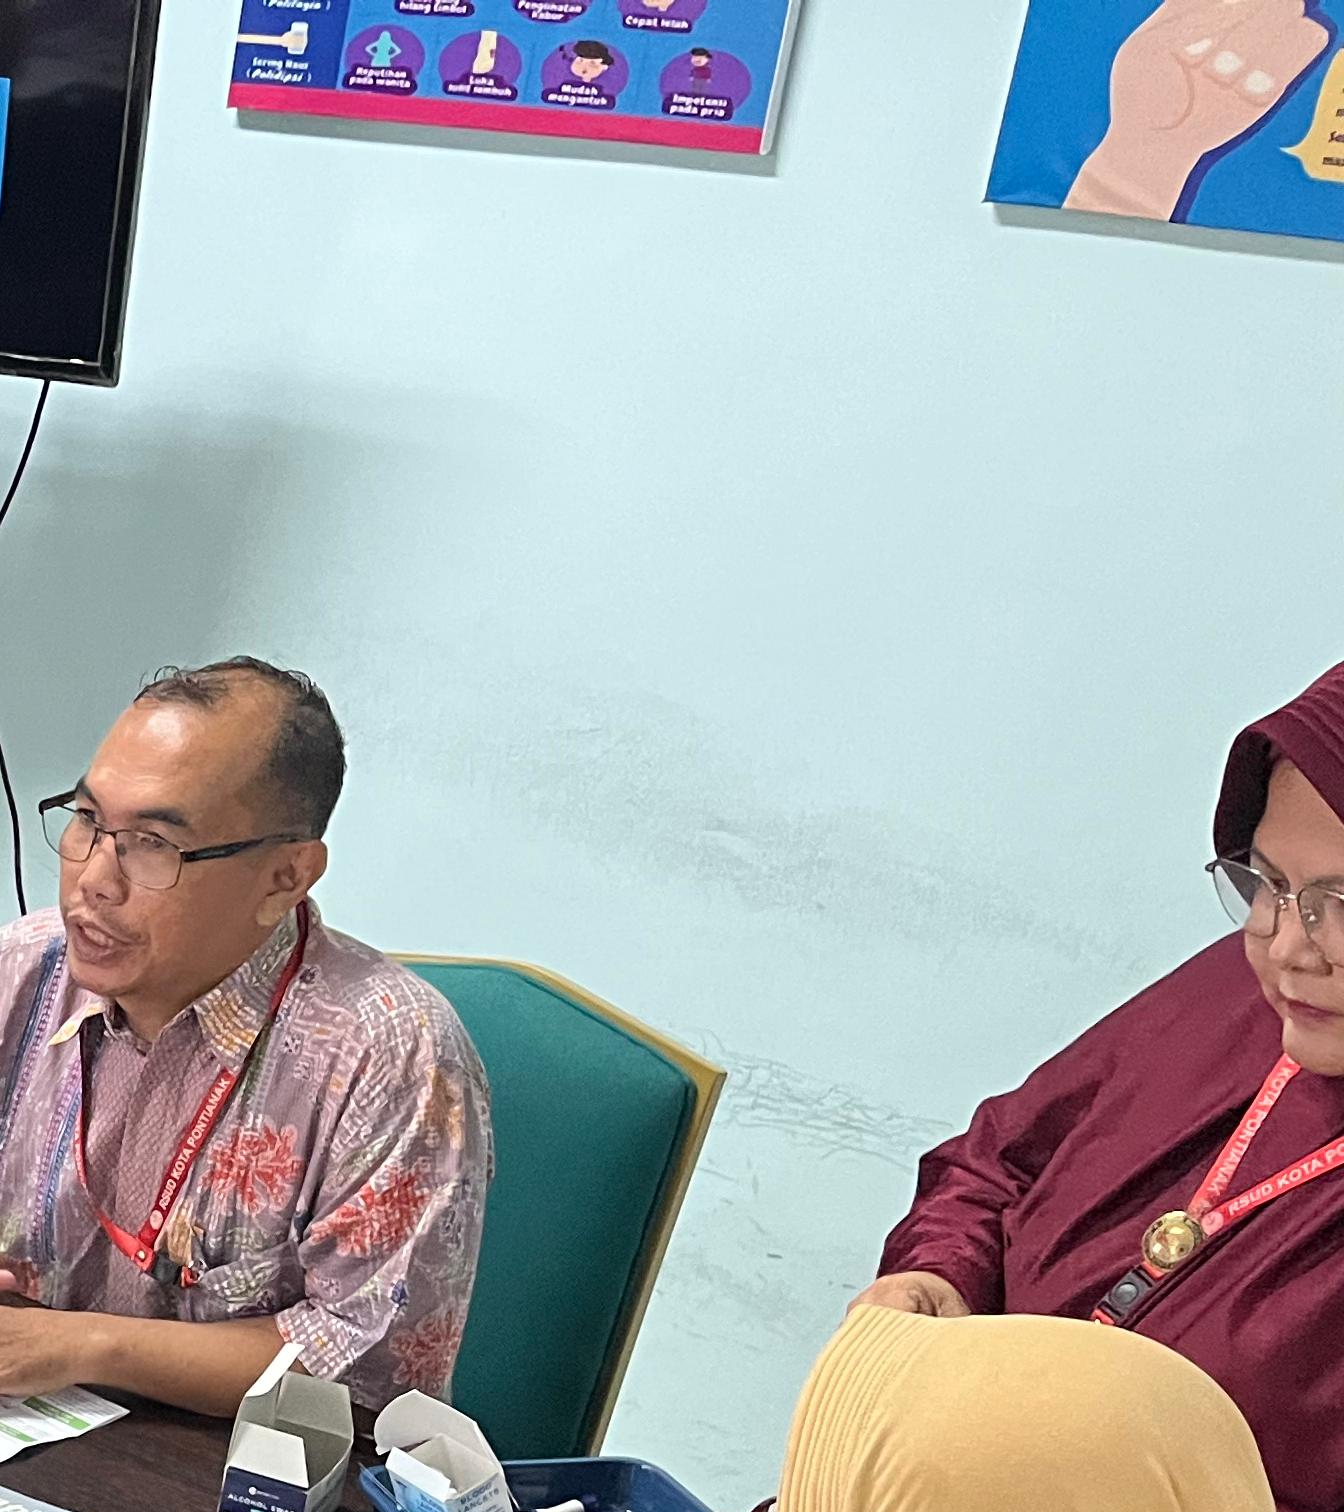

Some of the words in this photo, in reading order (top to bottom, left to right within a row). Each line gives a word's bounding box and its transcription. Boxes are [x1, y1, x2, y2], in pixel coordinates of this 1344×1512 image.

[159, 1179, 177, 1210] RSUD
[170, 1148, 193, 1179] KOTA
[187, 1077, 230, 1148] PONTIANAK
[1228, 1183, 1273, 1215] RSUD
[1277, 1158, 1324, 1189] KOTA
